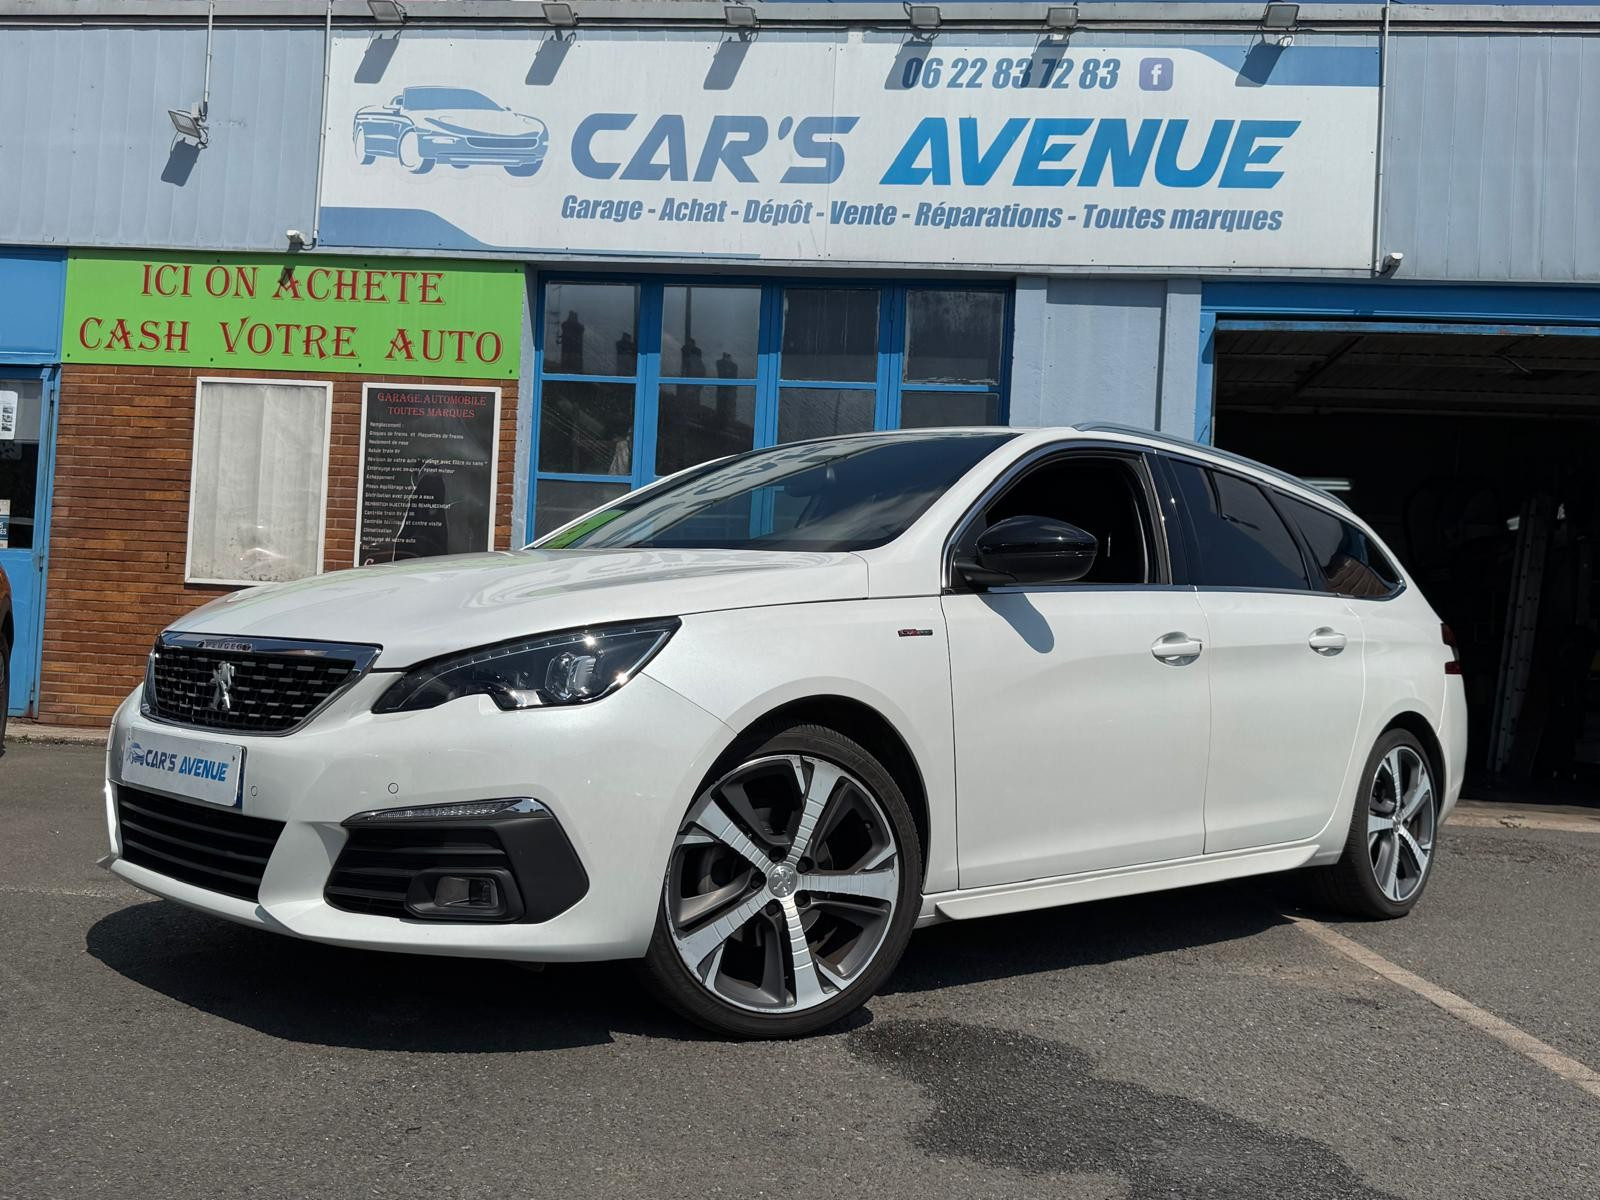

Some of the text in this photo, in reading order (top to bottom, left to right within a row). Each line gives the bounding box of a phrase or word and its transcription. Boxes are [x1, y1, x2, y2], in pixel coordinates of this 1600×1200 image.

[902, 57, 1121, 90] 06 22 83 72 83
[570, 112, 1302, 189] CAR'S AVENUE
[560, 194, 643, 223] Garage
[659, 197, 728, 223] Achat
[743, 197, 814, 226] Dépôt
[830, 201, 897, 226] Vente
[914, 201, 1063, 228] Réparations
[1082, 204, 1166, 230] Toutes
[1169, 207, 1284, 233] marques
[140, 263, 447, 305] ICI ON ACHETE
[79, 315, 505, 365] CASH VOTRE AUTO
[377, 392, 487, 406] GARAGE AUTOMOBILE
[387, 406, 475, 418] TOUTES MARQUES
[145, 749, 229, 782] CAR'S AVENUE
